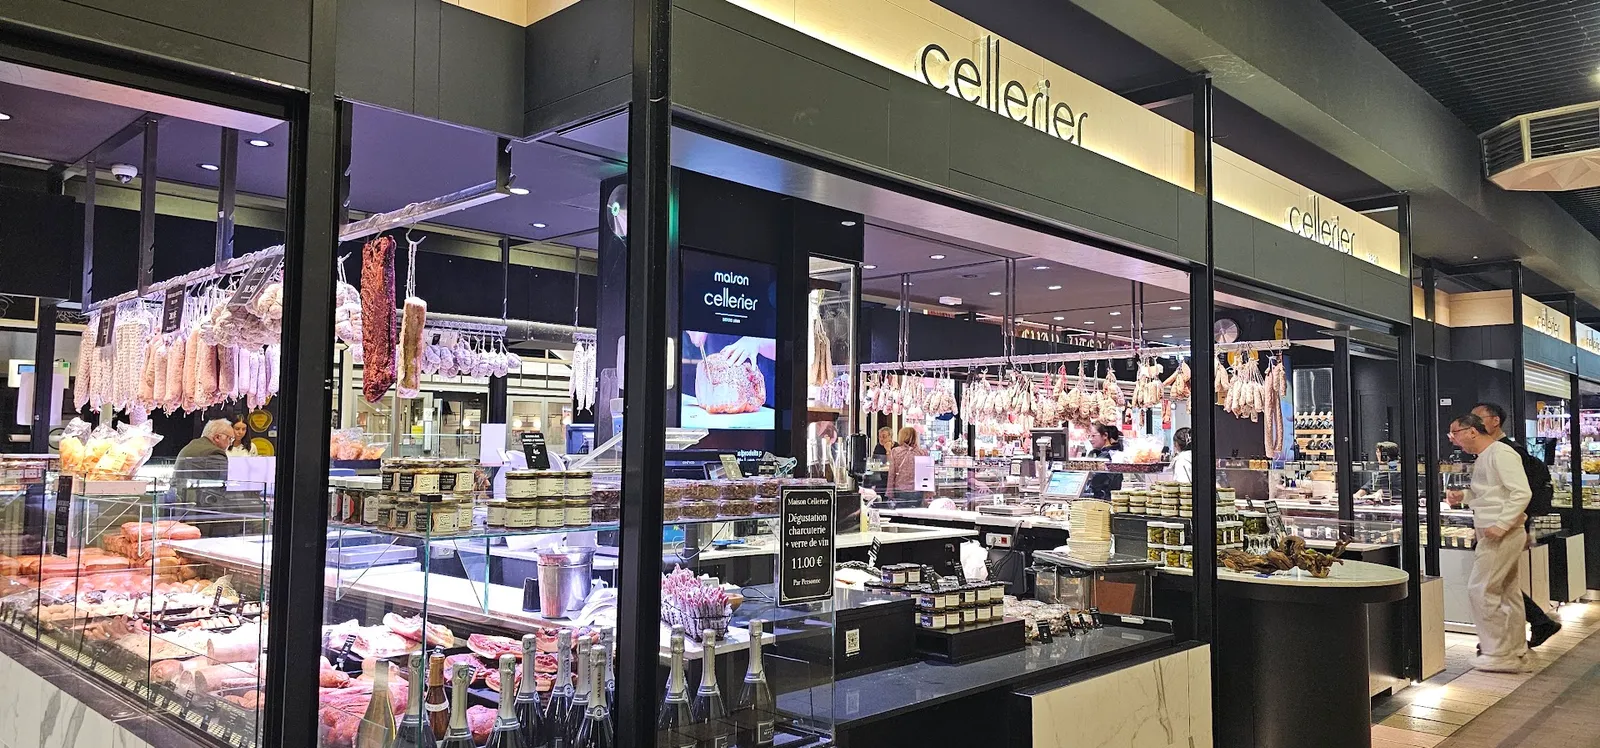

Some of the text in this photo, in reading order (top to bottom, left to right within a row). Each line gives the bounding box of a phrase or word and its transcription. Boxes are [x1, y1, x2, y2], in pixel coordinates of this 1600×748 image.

[920, 34, 1089, 146] cellerier
[1289, 194, 1356, 256] cellerier
[714, 271, 749, 286] maison
[703, 287, 758, 311] cellerier
[787, 497, 829, 506] Maison Cellerier
[788, 512, 828, 525] Dégustation
[788, 525, 826, 536] charcuterie
[790, 539, 808, 548] verre
[809, 537, 818, 547] de
[818, 537, 829, 547] vin
[791, 555, 823, 570] 11.00 €
